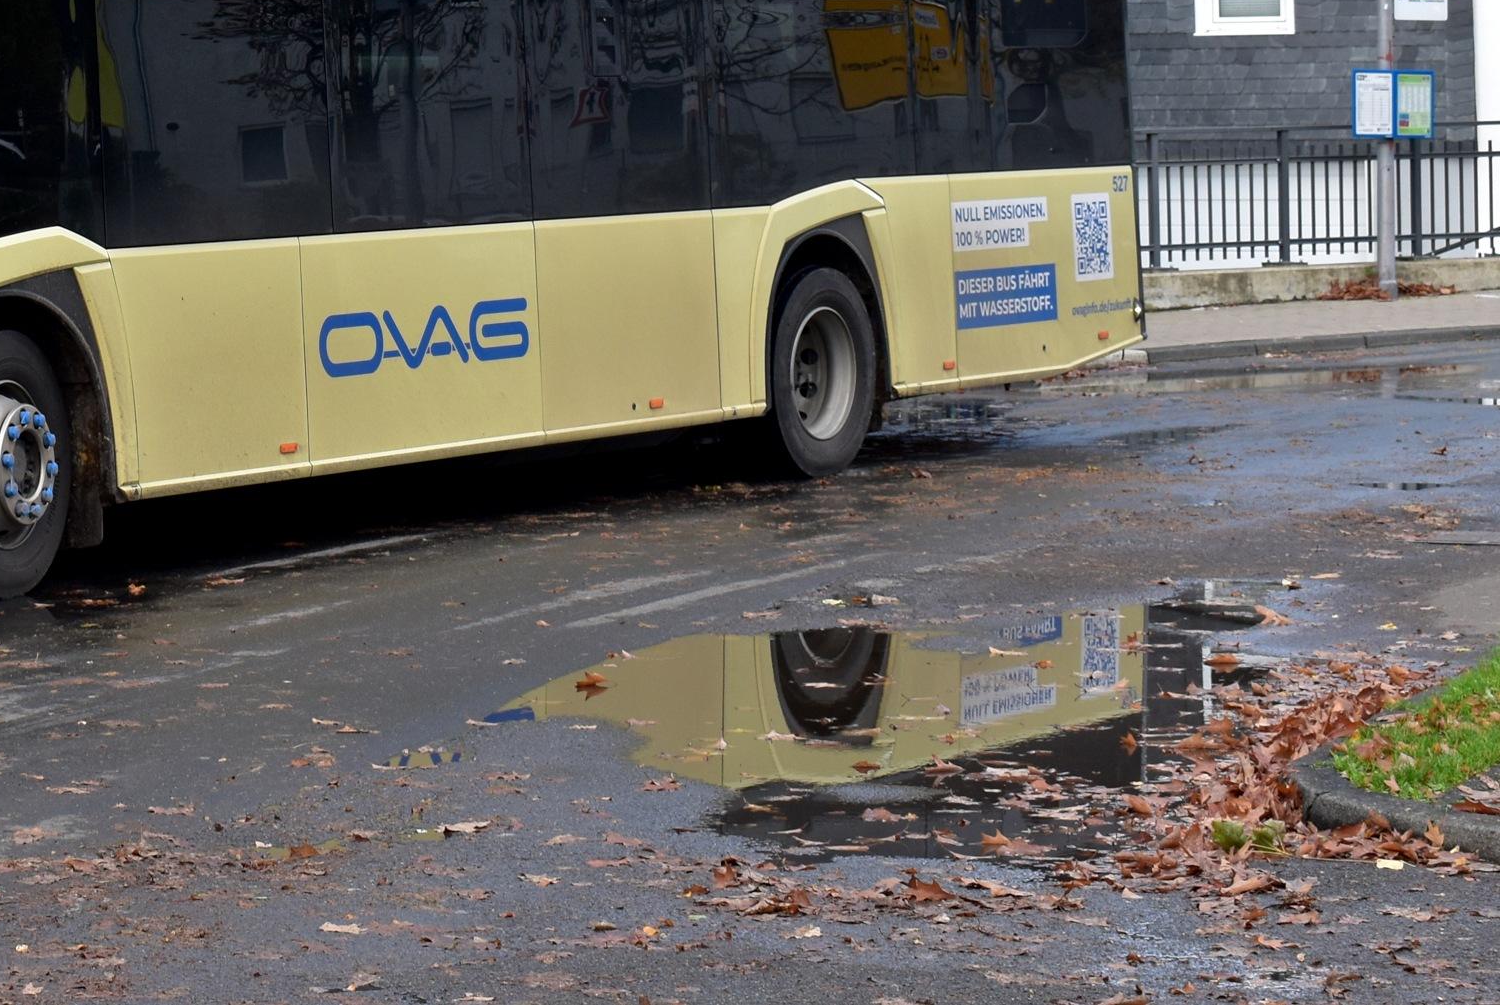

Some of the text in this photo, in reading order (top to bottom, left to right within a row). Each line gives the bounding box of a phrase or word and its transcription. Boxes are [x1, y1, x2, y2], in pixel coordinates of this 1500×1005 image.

[1112, 175, 1129, 192] 527
[954, 203, 1046, 223] NULL EMISSIONEN.
[955, 228, 1026, 247] 100 % POWER!
[958, 270, 1051, 295] DIESER BUS FÄHRT
[959, 295, 1054, 319] MIT WASSERSTOFF.
[319, 297, 530, 378] OVAG
